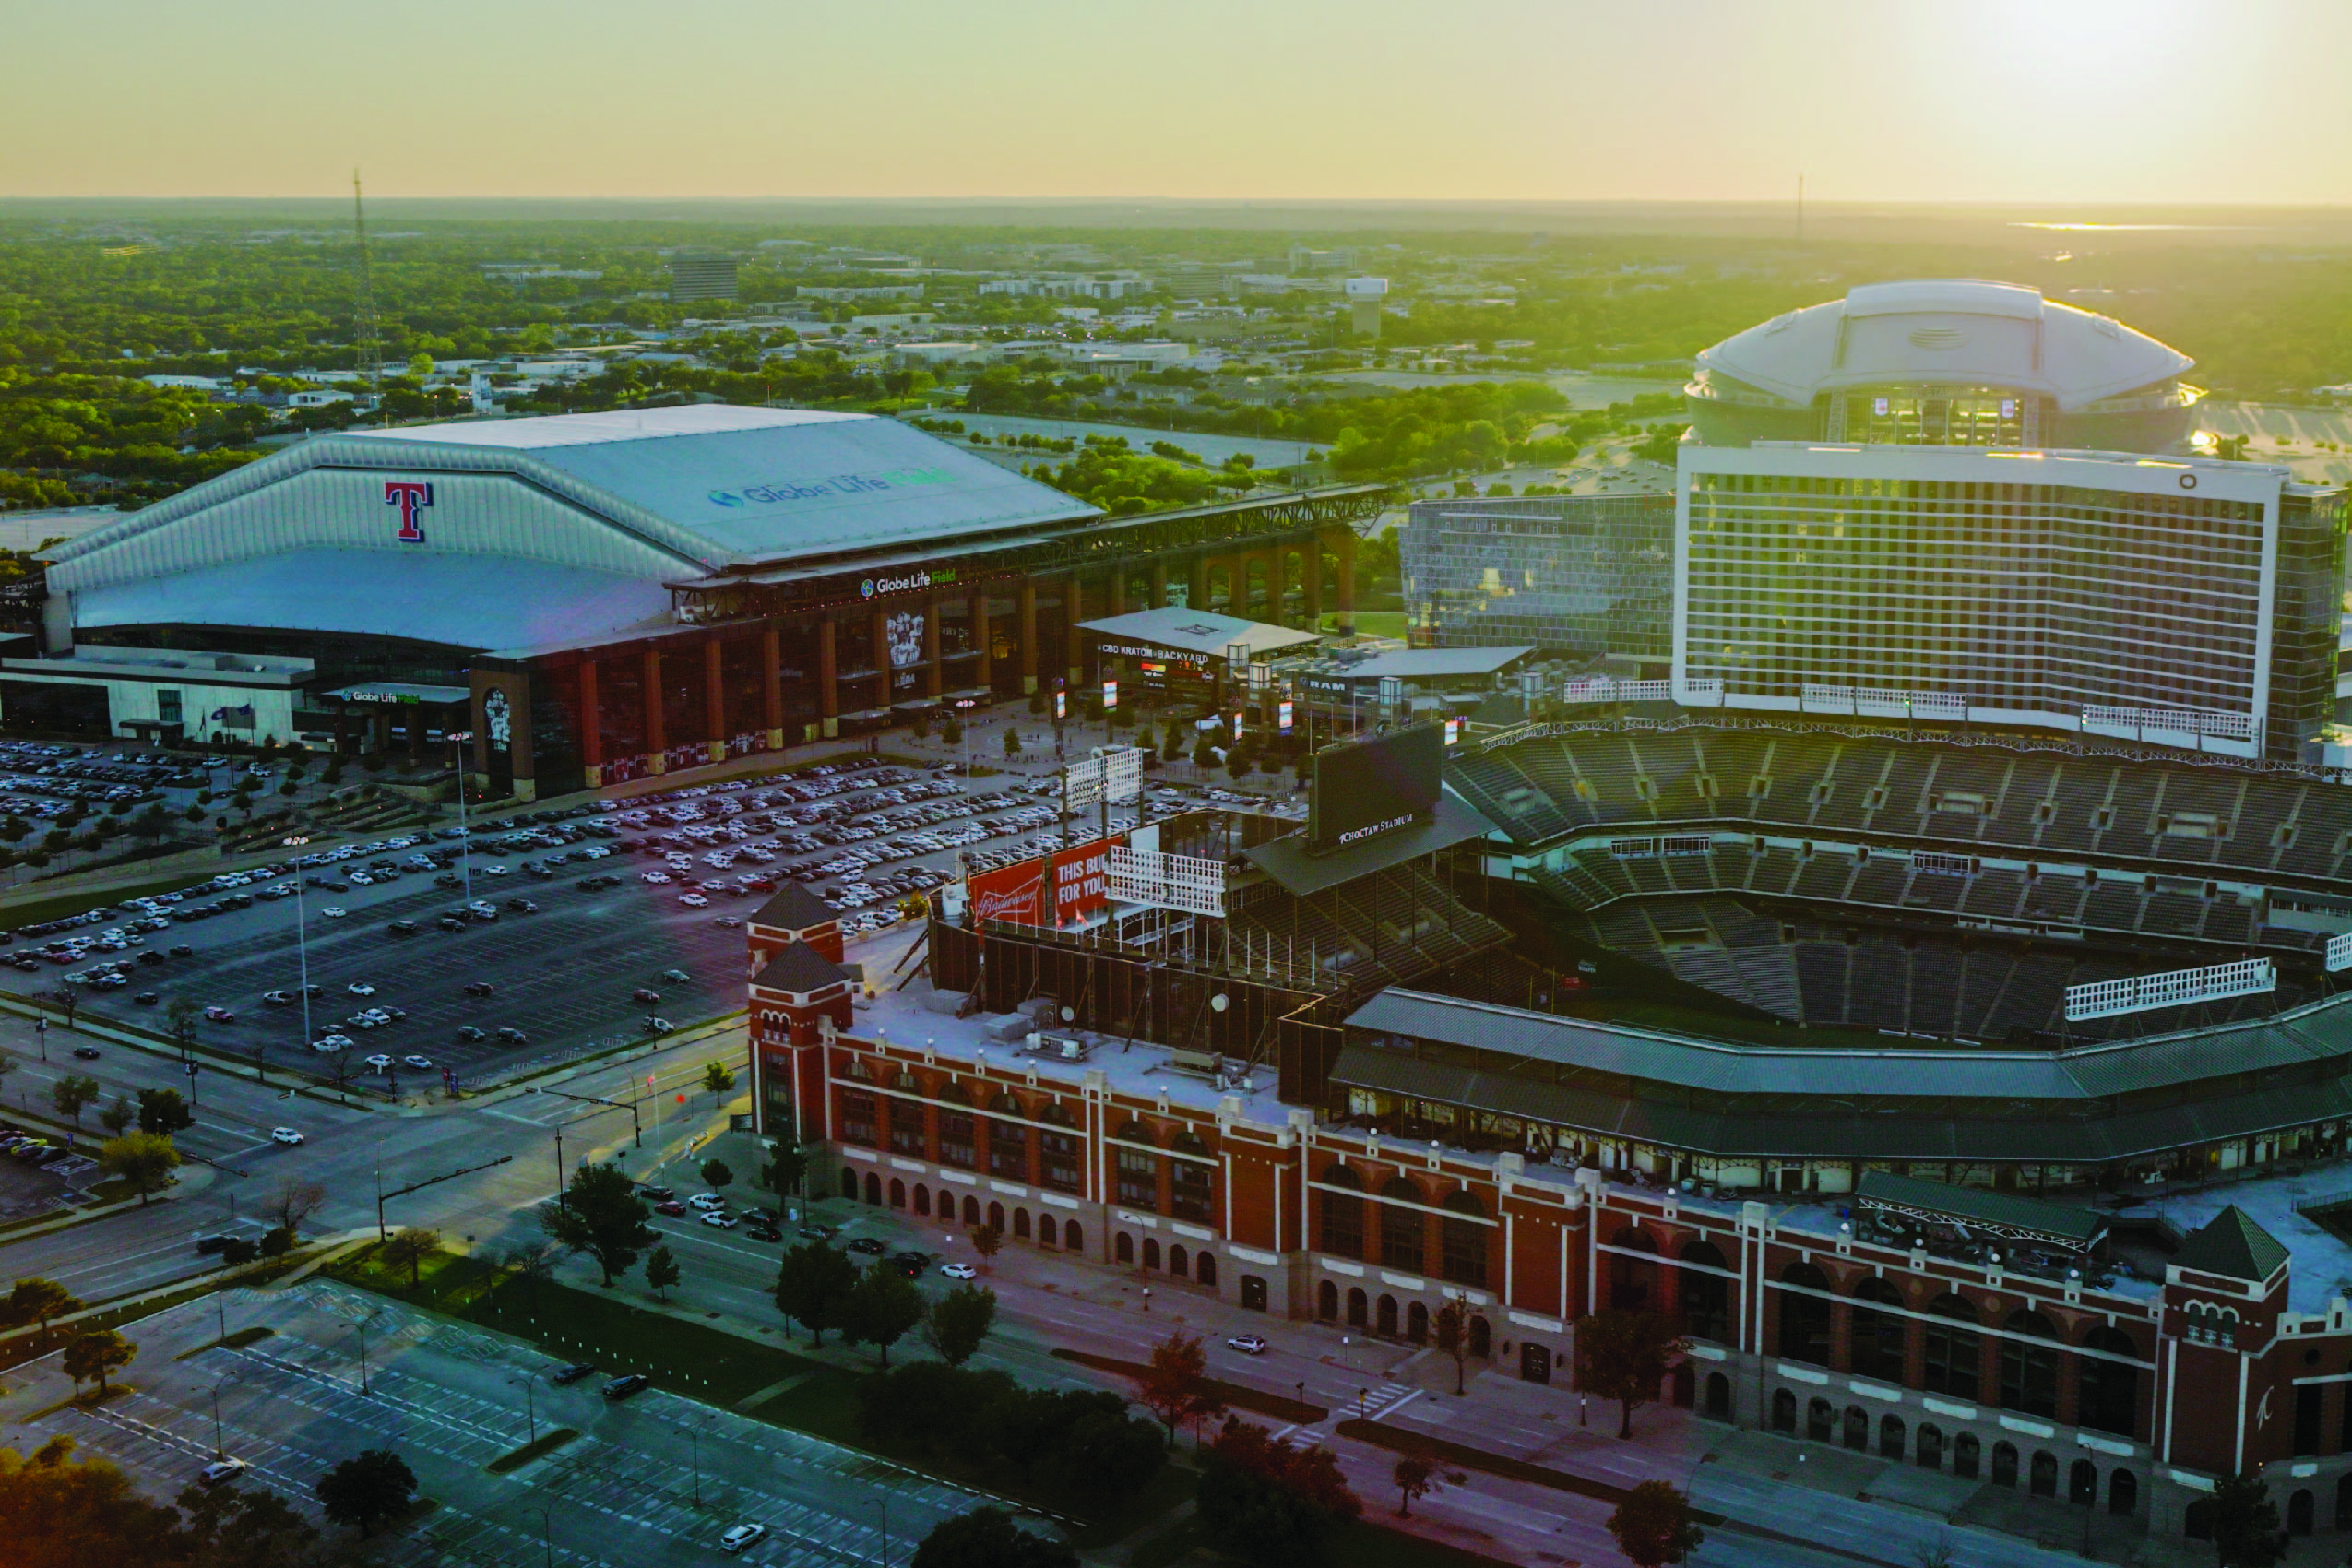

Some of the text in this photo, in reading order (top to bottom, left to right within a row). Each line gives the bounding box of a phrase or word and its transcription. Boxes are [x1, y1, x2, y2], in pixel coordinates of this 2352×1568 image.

[742, 482, 835, 504] Globe
[826, 474, 891, 493] Life
[384, 481, 434, 542] T
[877, 568, 956, 593] Globe Life Field
[1102, 644, 1209, 663] CBD KRATOM BACKYARD
[1310, 680, 1346, 691] RAM
[353, 691, 379, 702] Globe
[381, 693, 398, 704] Life
[1380, 813, 1413, 832] STADIUM
[1057, 860, 1084, 884] THIS
[978, 889, 1035, 916] Budweiser
[1058, 883, 1081, 905] FOR
